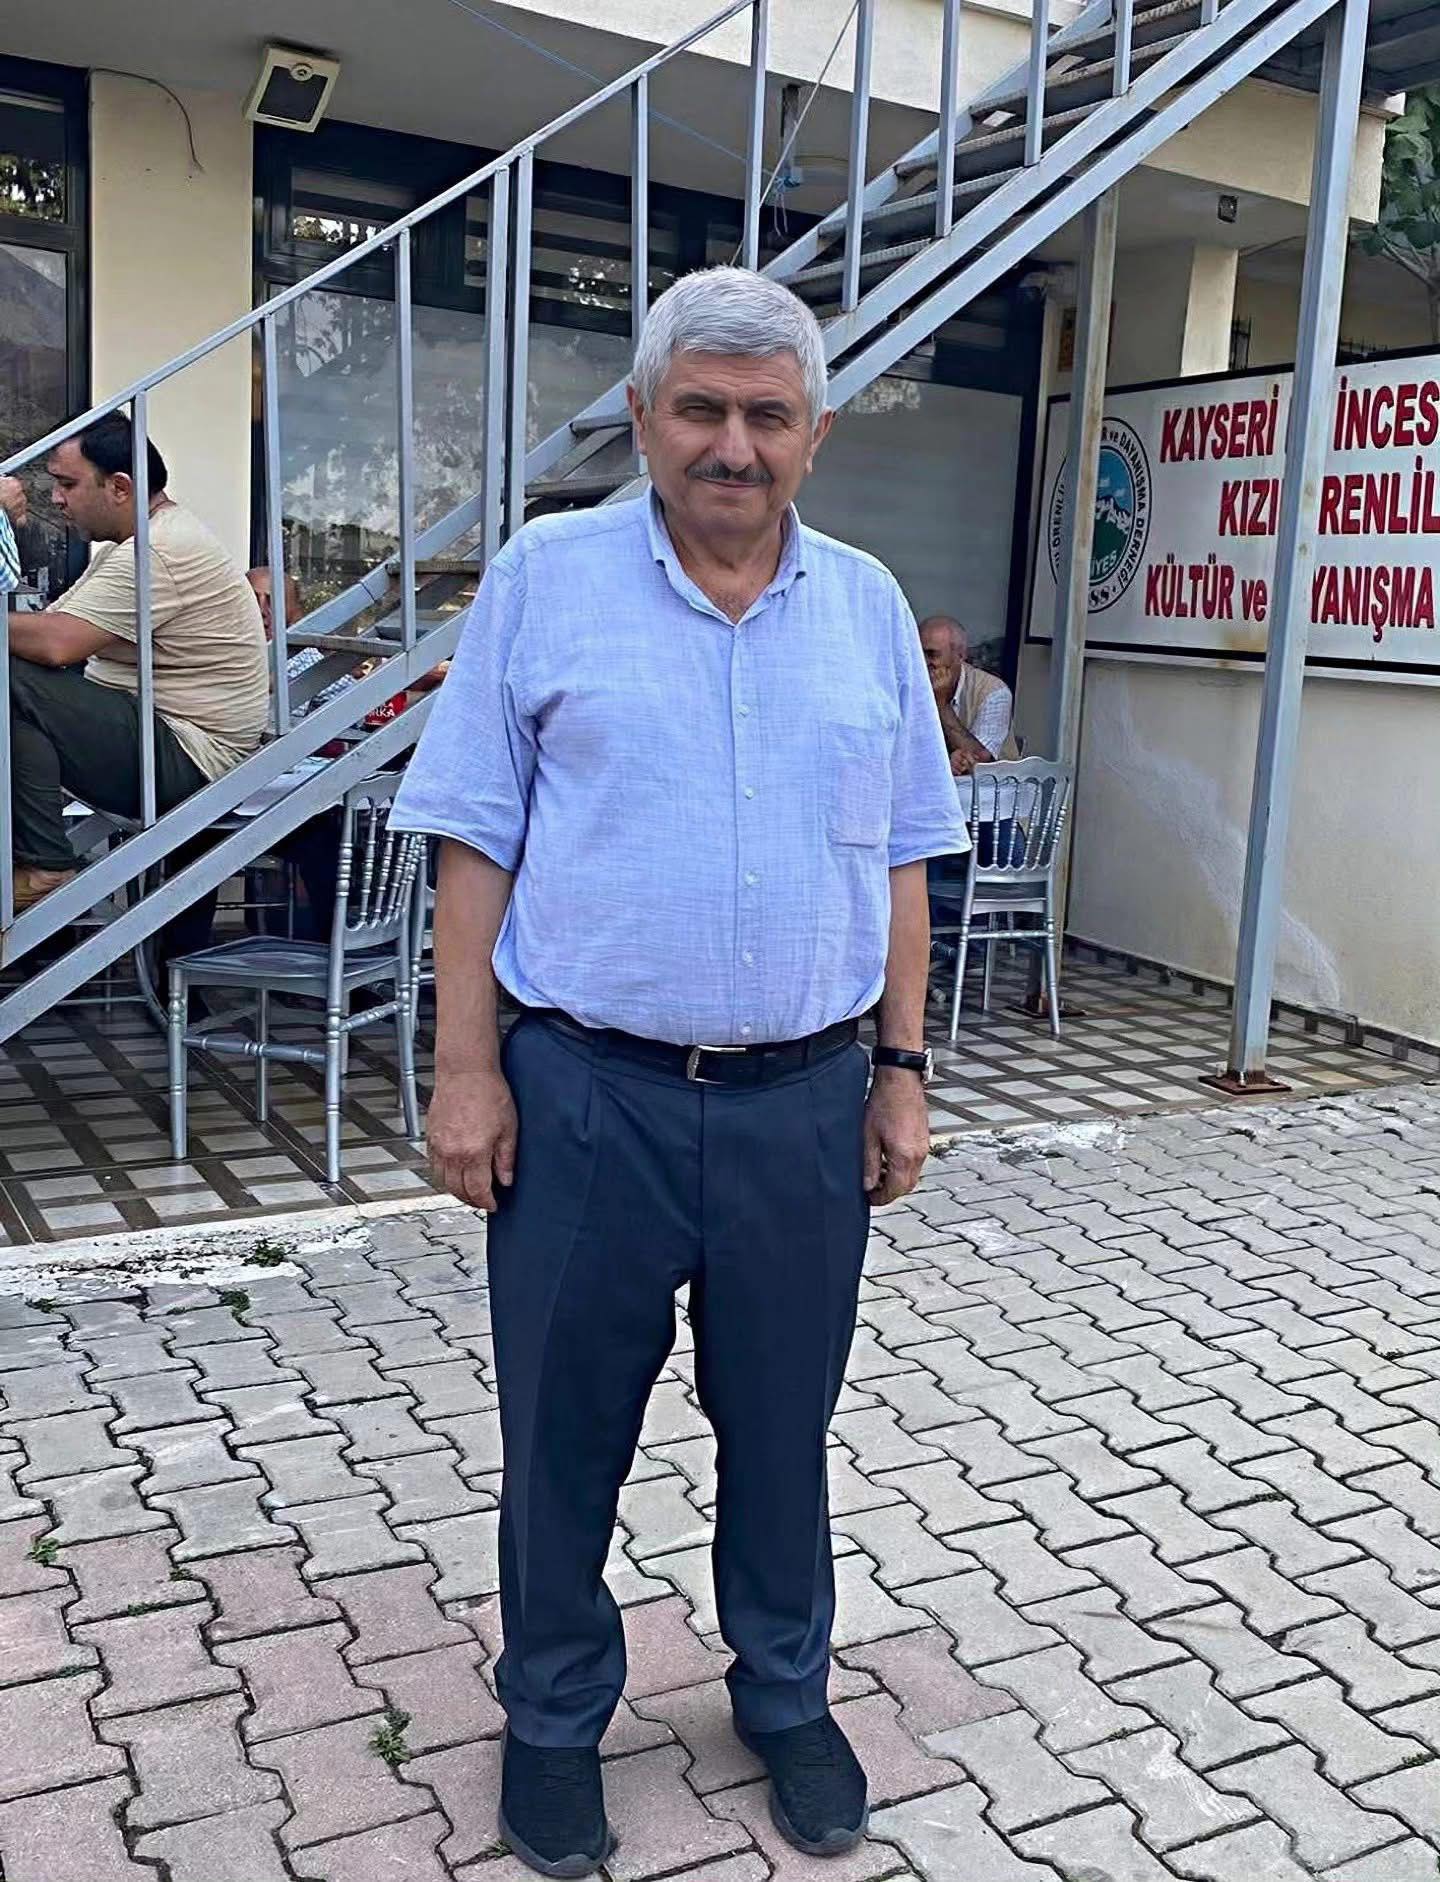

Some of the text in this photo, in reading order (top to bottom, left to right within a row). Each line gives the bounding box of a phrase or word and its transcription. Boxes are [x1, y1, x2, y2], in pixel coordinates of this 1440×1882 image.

[1160, 383, 1279, 463] KAYSERİ
[1333, 375, 1440, 451] İNCES
[1145, 553, 1435, 643] KÜLTÜR ve YANIŞMA
